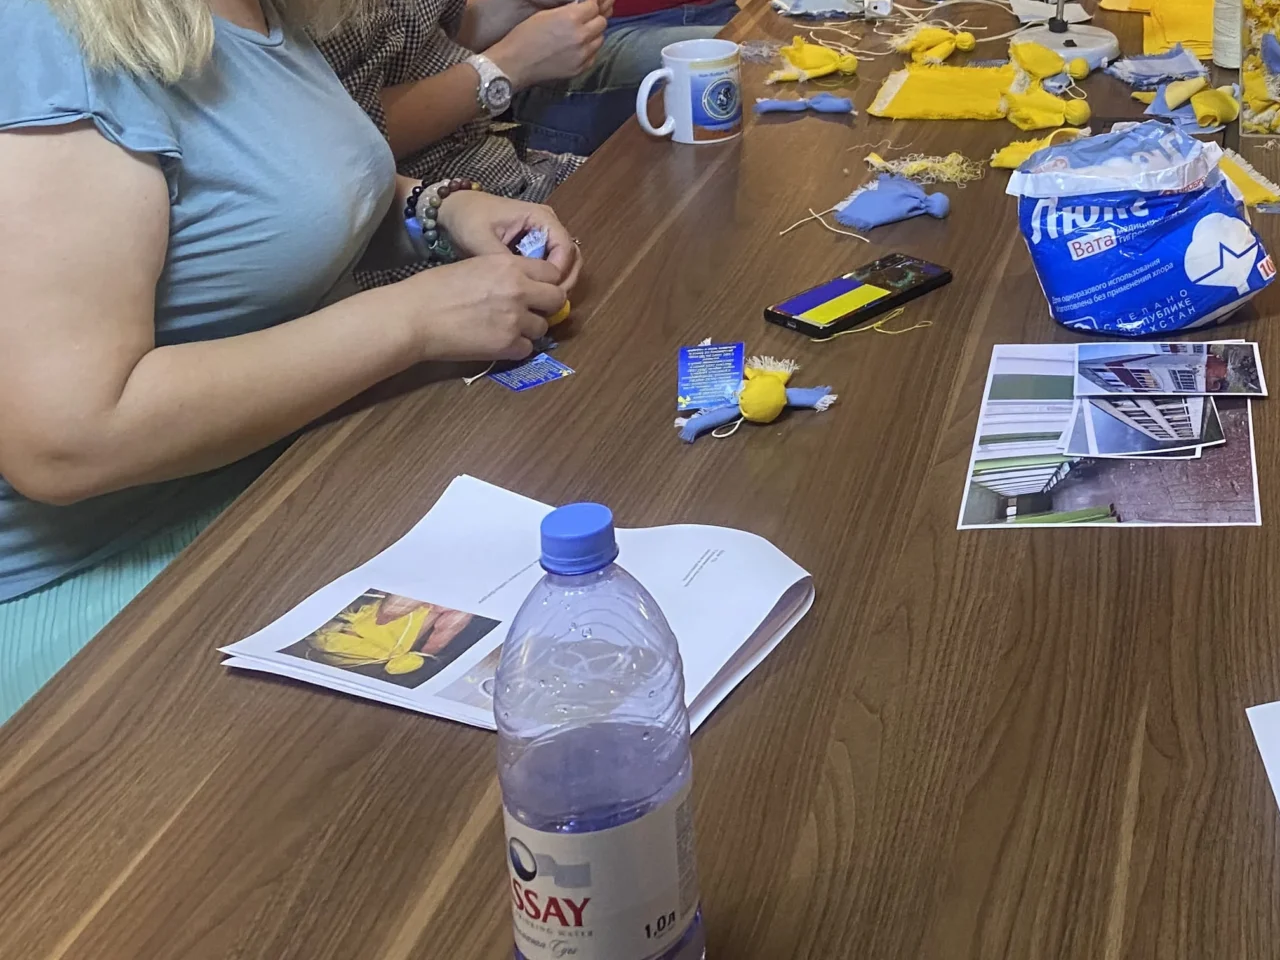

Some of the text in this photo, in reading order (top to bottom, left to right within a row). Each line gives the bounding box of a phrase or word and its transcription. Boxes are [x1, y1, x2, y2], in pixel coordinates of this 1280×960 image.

[1071, 235, 1115, 258] Вата
[1061, 282, 1107, 302] одноразового
[1107, 257, 1161, 287] использования
[1093, 293, 1107, 303] без
[1106, 273, 1152, 298] применения
[1152, 262, 1174, 278] хлора
[512, 878, 591, 927] SSAY
